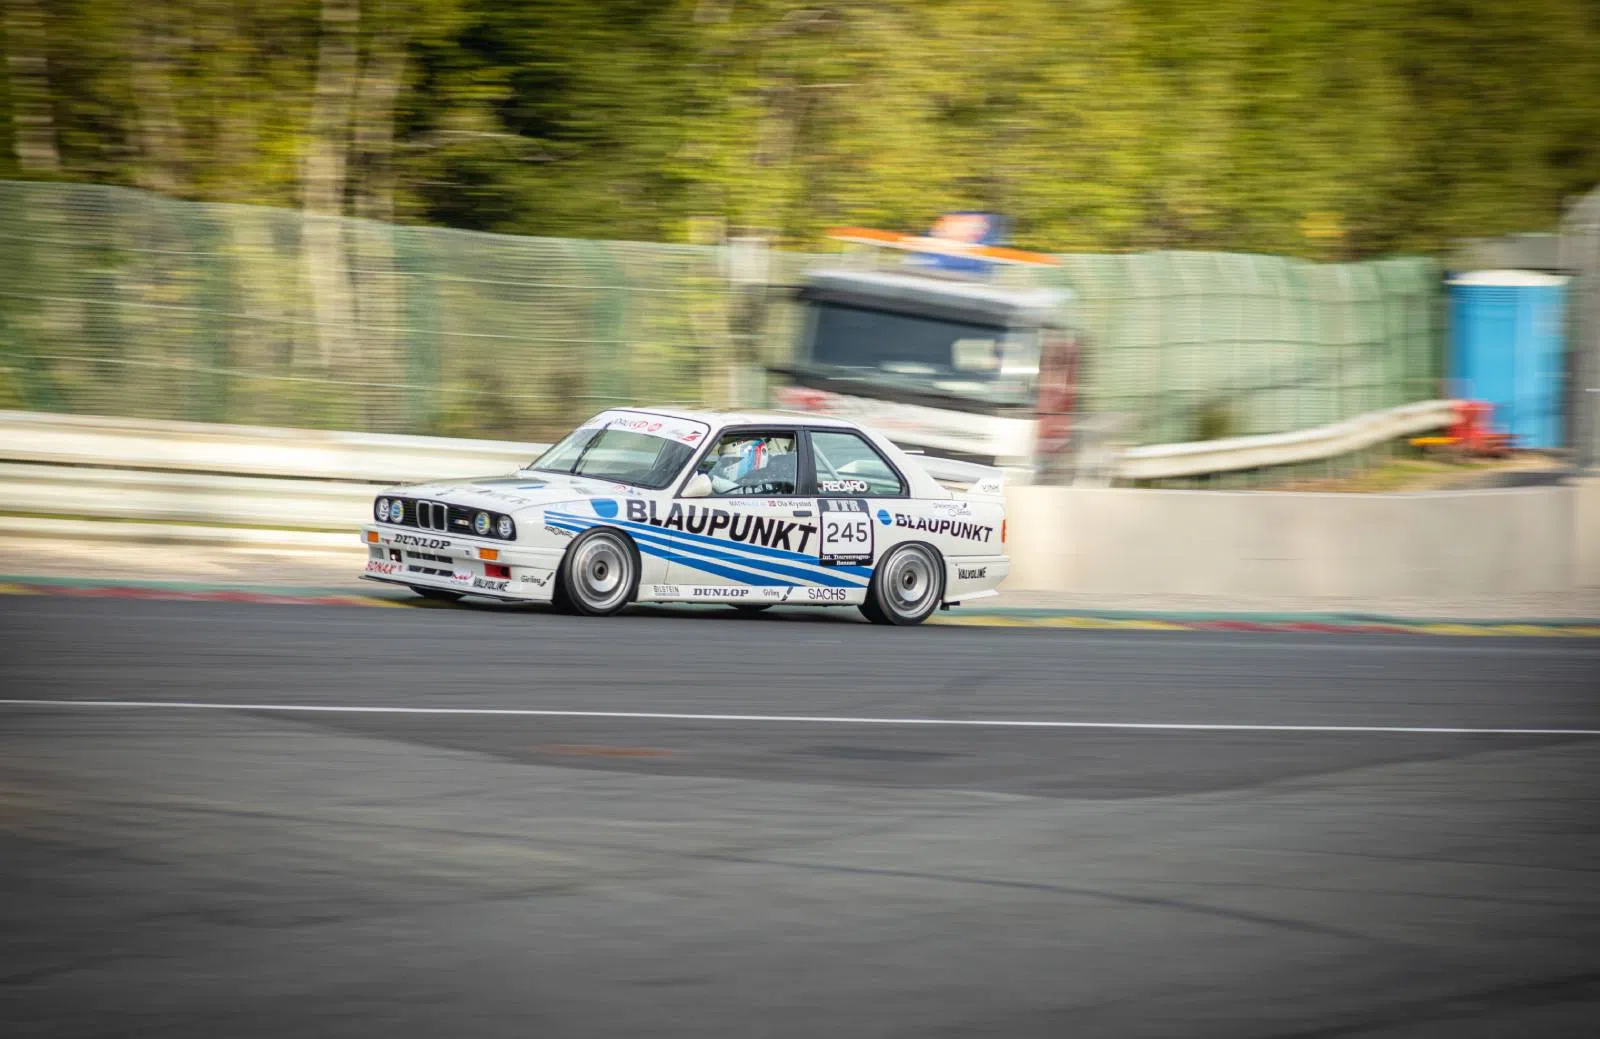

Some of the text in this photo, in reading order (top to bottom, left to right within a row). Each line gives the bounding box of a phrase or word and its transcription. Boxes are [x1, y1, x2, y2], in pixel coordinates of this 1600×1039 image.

[822, 480, 868, 492] RECARO
[626, 499, 818, 554] BLAUPUNKT
[826, 522, 868, 543] 245
[896, 513, 994, 543] BLAUPUNKT
[393, 533, 452, 550] DUNLOP
[958, 567, 987, 580] VALVOLINE
[472, 576, 511, 592] VALVOLINE
[693, 587, 750, 598] DUNLOP
[808, 588, 846, 601] SACHS
